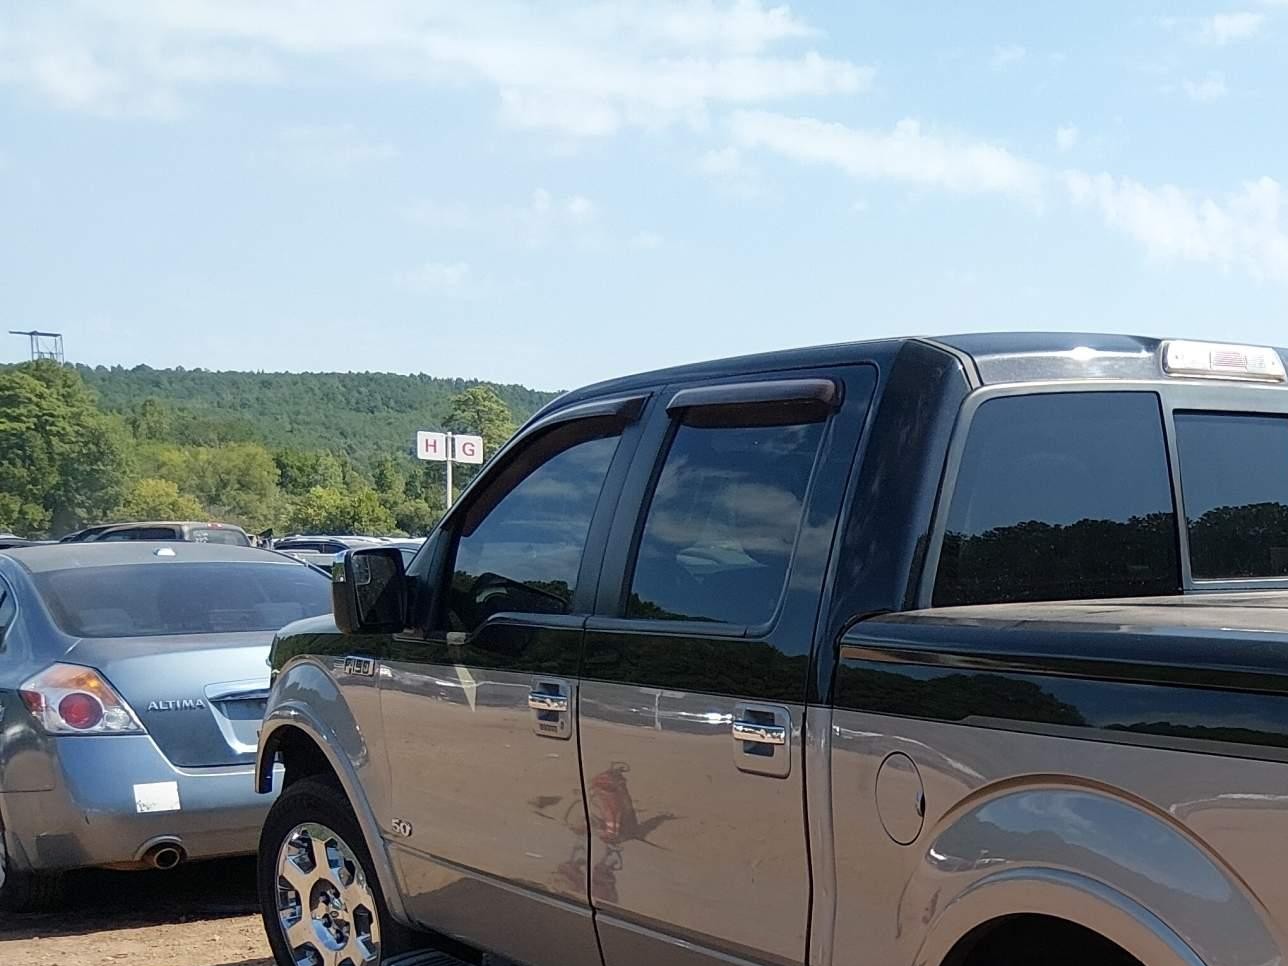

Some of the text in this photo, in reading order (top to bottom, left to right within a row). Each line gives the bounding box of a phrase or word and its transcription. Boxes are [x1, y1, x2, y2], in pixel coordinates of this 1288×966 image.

[425, 438, 437, 453] H
[461, 441, 475, 457] G
[147, 697, 207, 711] ALTIMA
